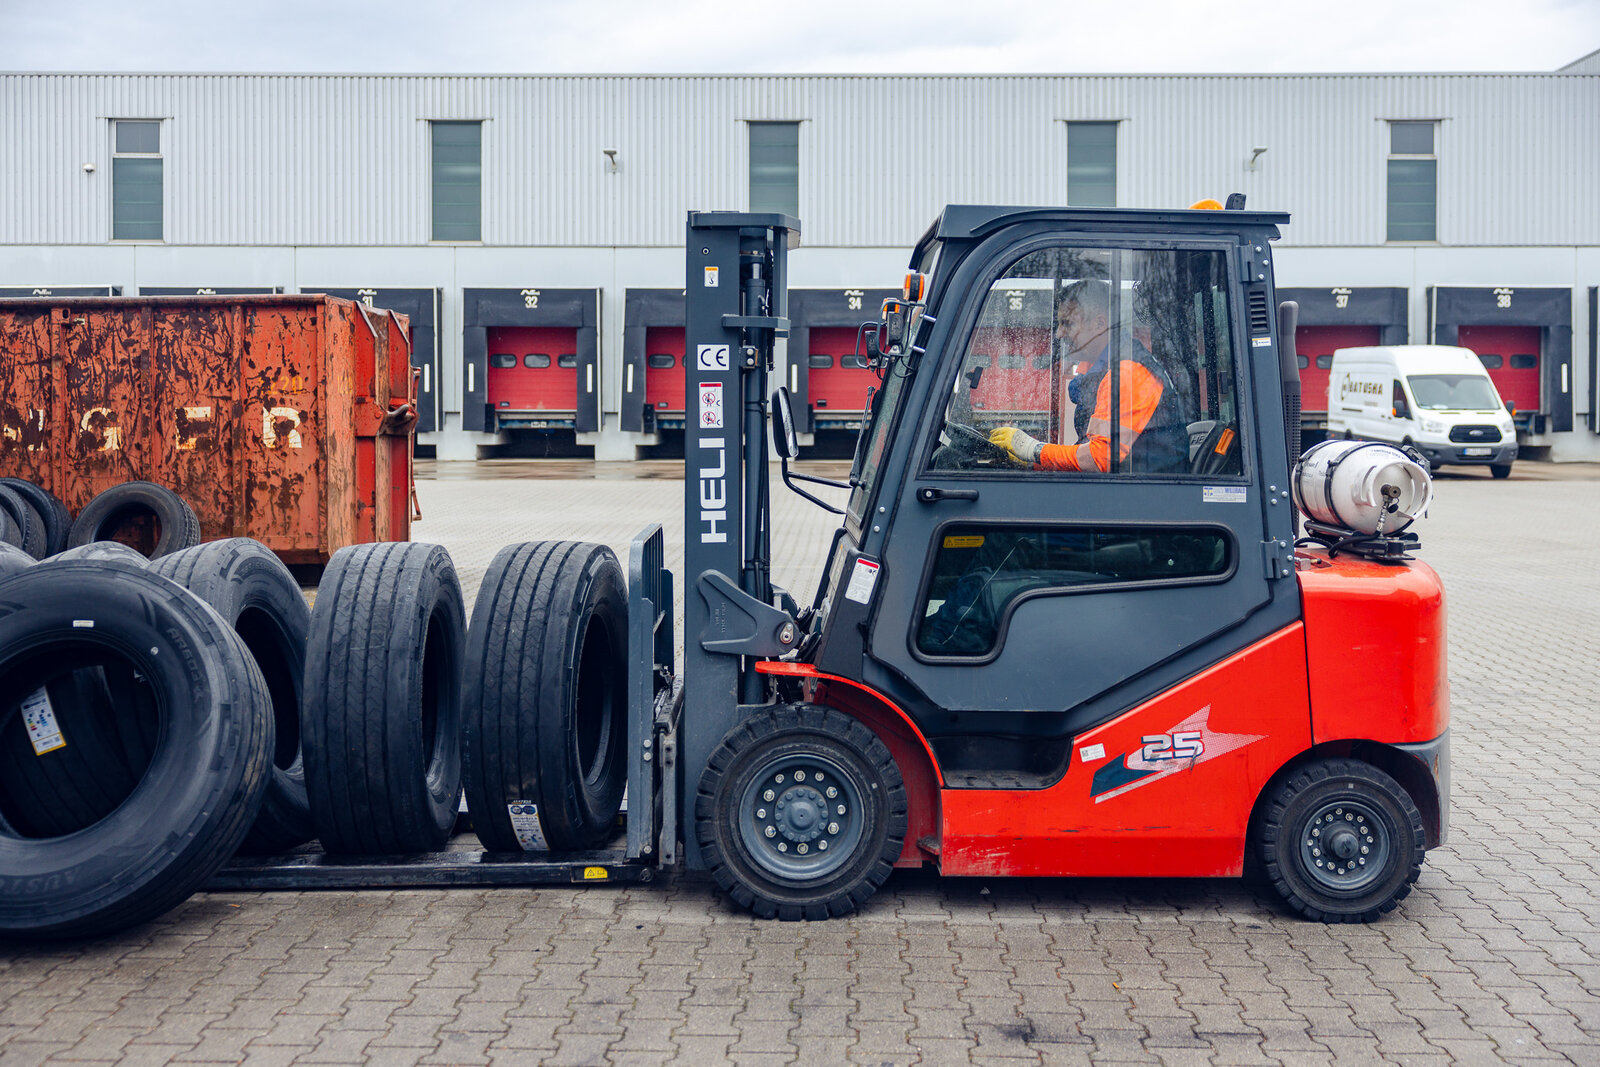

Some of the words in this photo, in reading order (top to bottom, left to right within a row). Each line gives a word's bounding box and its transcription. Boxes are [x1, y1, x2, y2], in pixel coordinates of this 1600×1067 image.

[524, 295, 538, 309] 32
[848, 296, 862, 310] 34
[1008, 297, 1023, 310] 35
[1335, 294, 1349, 308] 37
[1497, 294, 1511, 308] 38
[698, 437, 728, 544] HELI
[1141, 731, 1205, 762] 25
